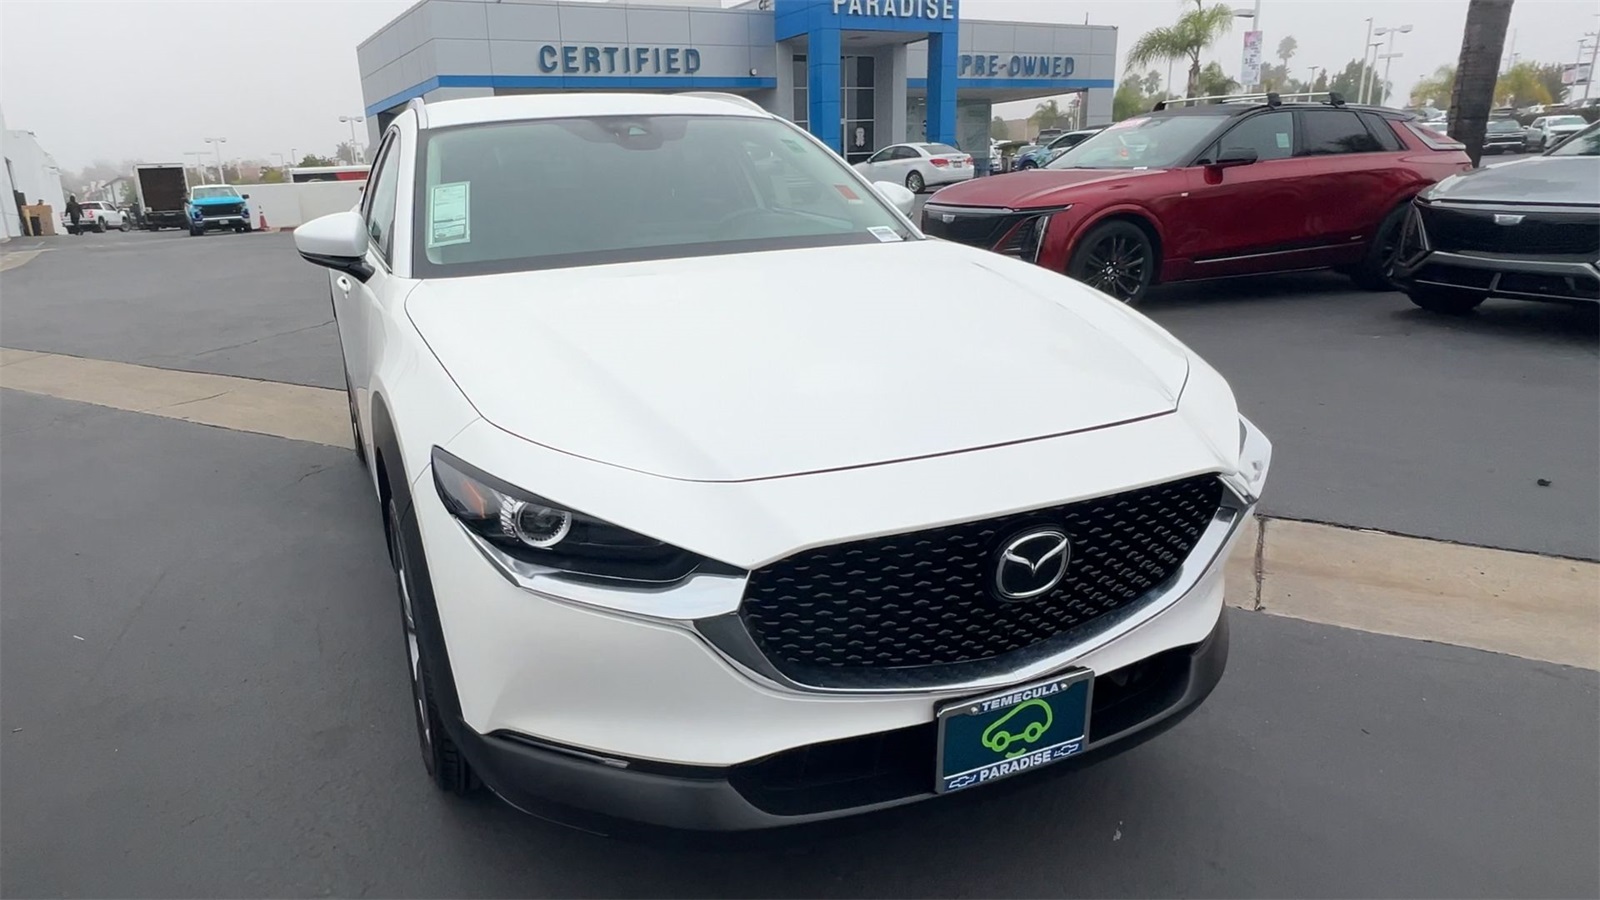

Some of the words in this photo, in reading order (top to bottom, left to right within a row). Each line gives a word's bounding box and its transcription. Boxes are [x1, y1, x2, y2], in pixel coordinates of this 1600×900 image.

[832, 0, 955, 20] PARADISE
[539, 44, 701, 74] CERTIFIED
[958, 54, 1075, 77] PRE-OWNED
[982, 683, 1060, 712] TEMECULA
[979, 750, 1052, 782] PARADISE
